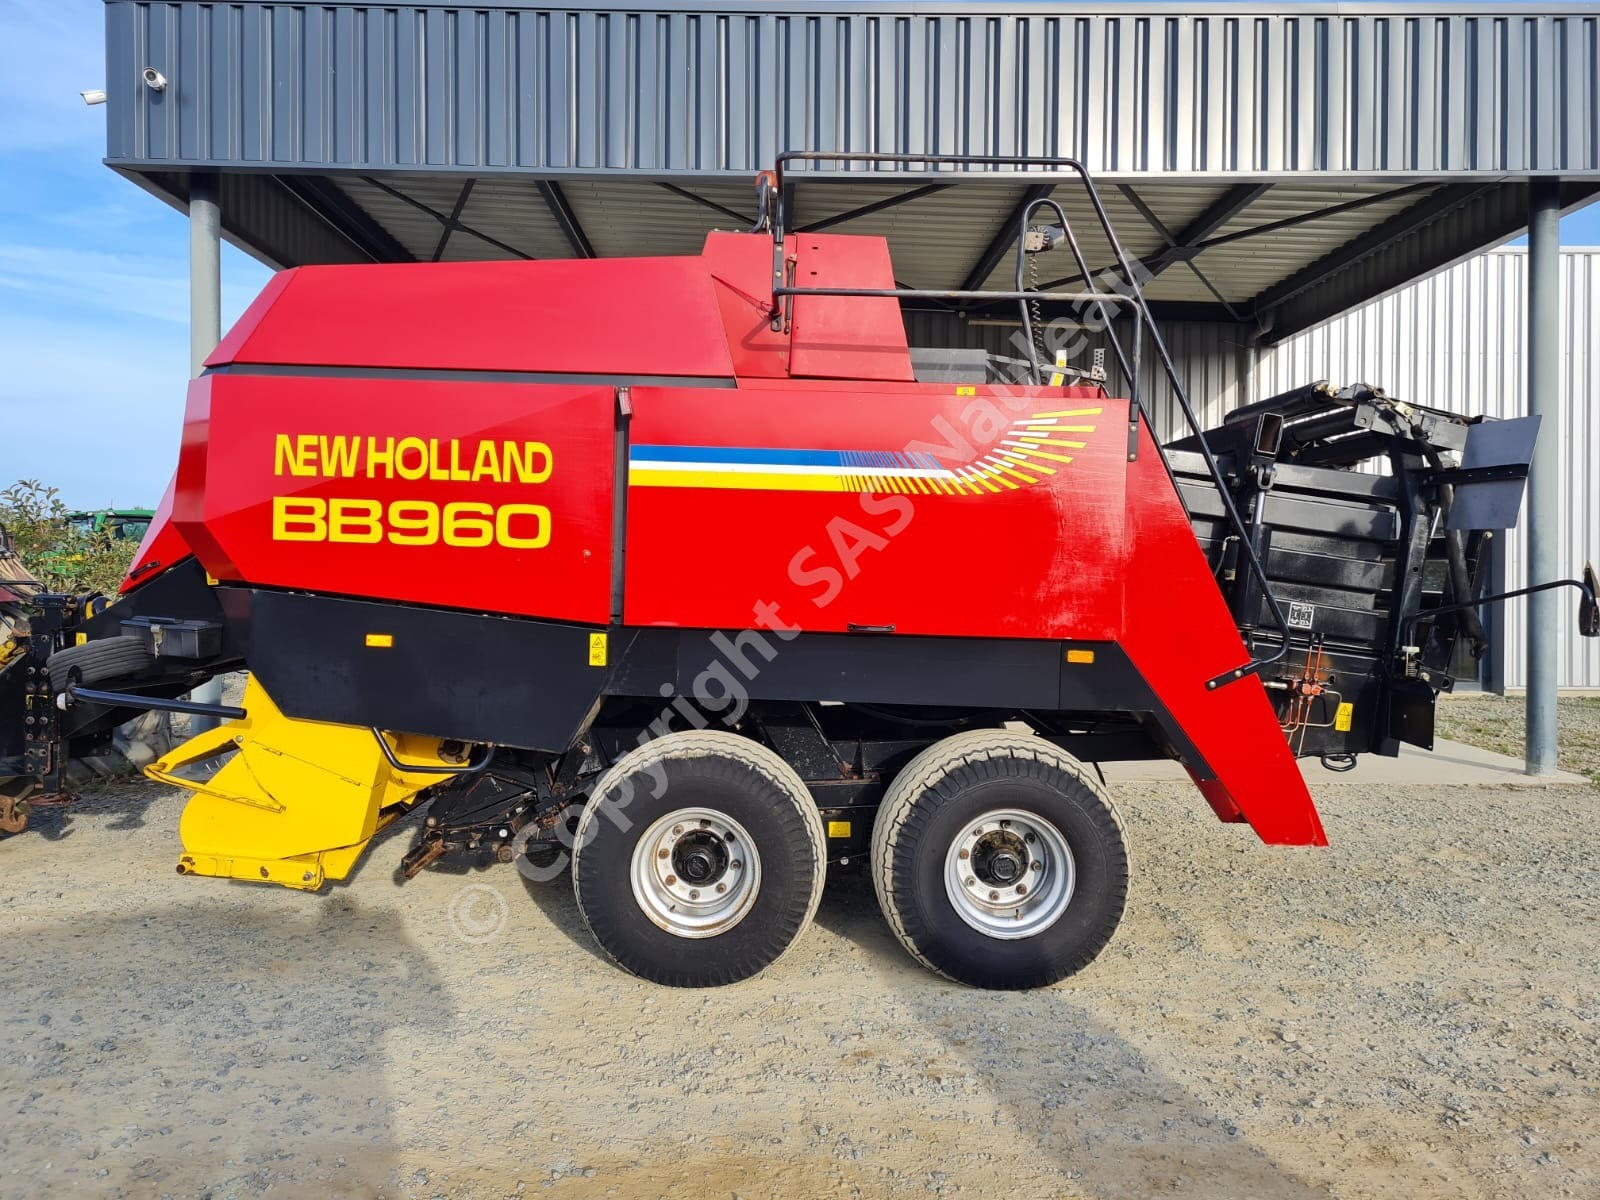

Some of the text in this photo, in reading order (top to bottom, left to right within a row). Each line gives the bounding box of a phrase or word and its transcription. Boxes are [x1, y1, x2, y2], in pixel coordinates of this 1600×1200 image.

[274, 434, 553, 484] NEW HOLLAND
[273, 496, 552, 549] BB960
